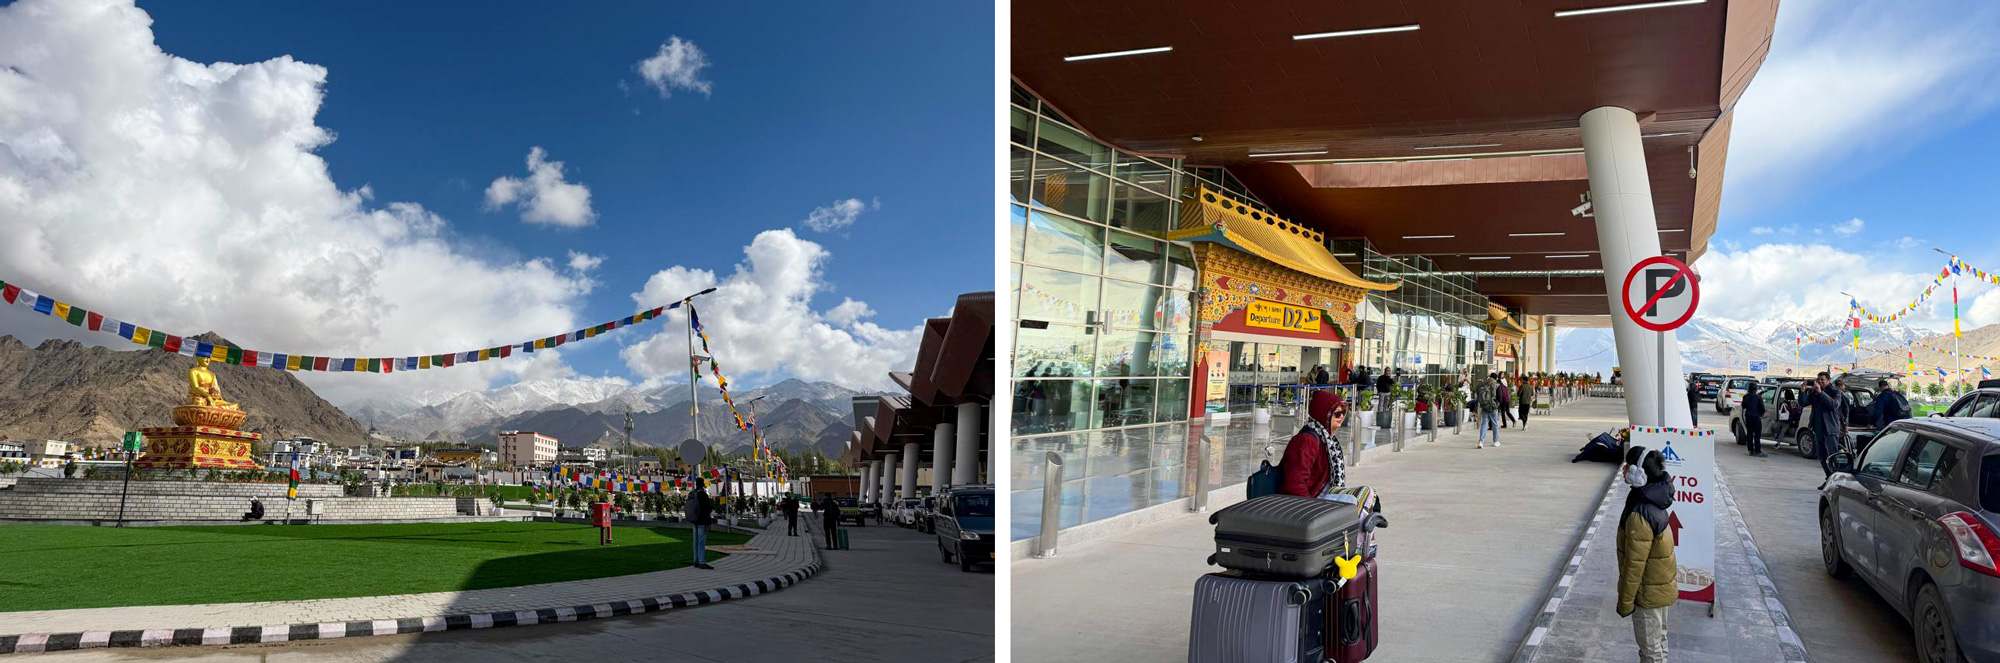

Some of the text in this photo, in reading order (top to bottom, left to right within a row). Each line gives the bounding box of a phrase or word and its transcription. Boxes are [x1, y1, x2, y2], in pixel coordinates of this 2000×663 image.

[1645, 269, 1686, 317] P
[1250, 312, 1281, 325] Departure
[1283, 306, 1304, 329] D2
[1679, 475, 1698, 488] TO
